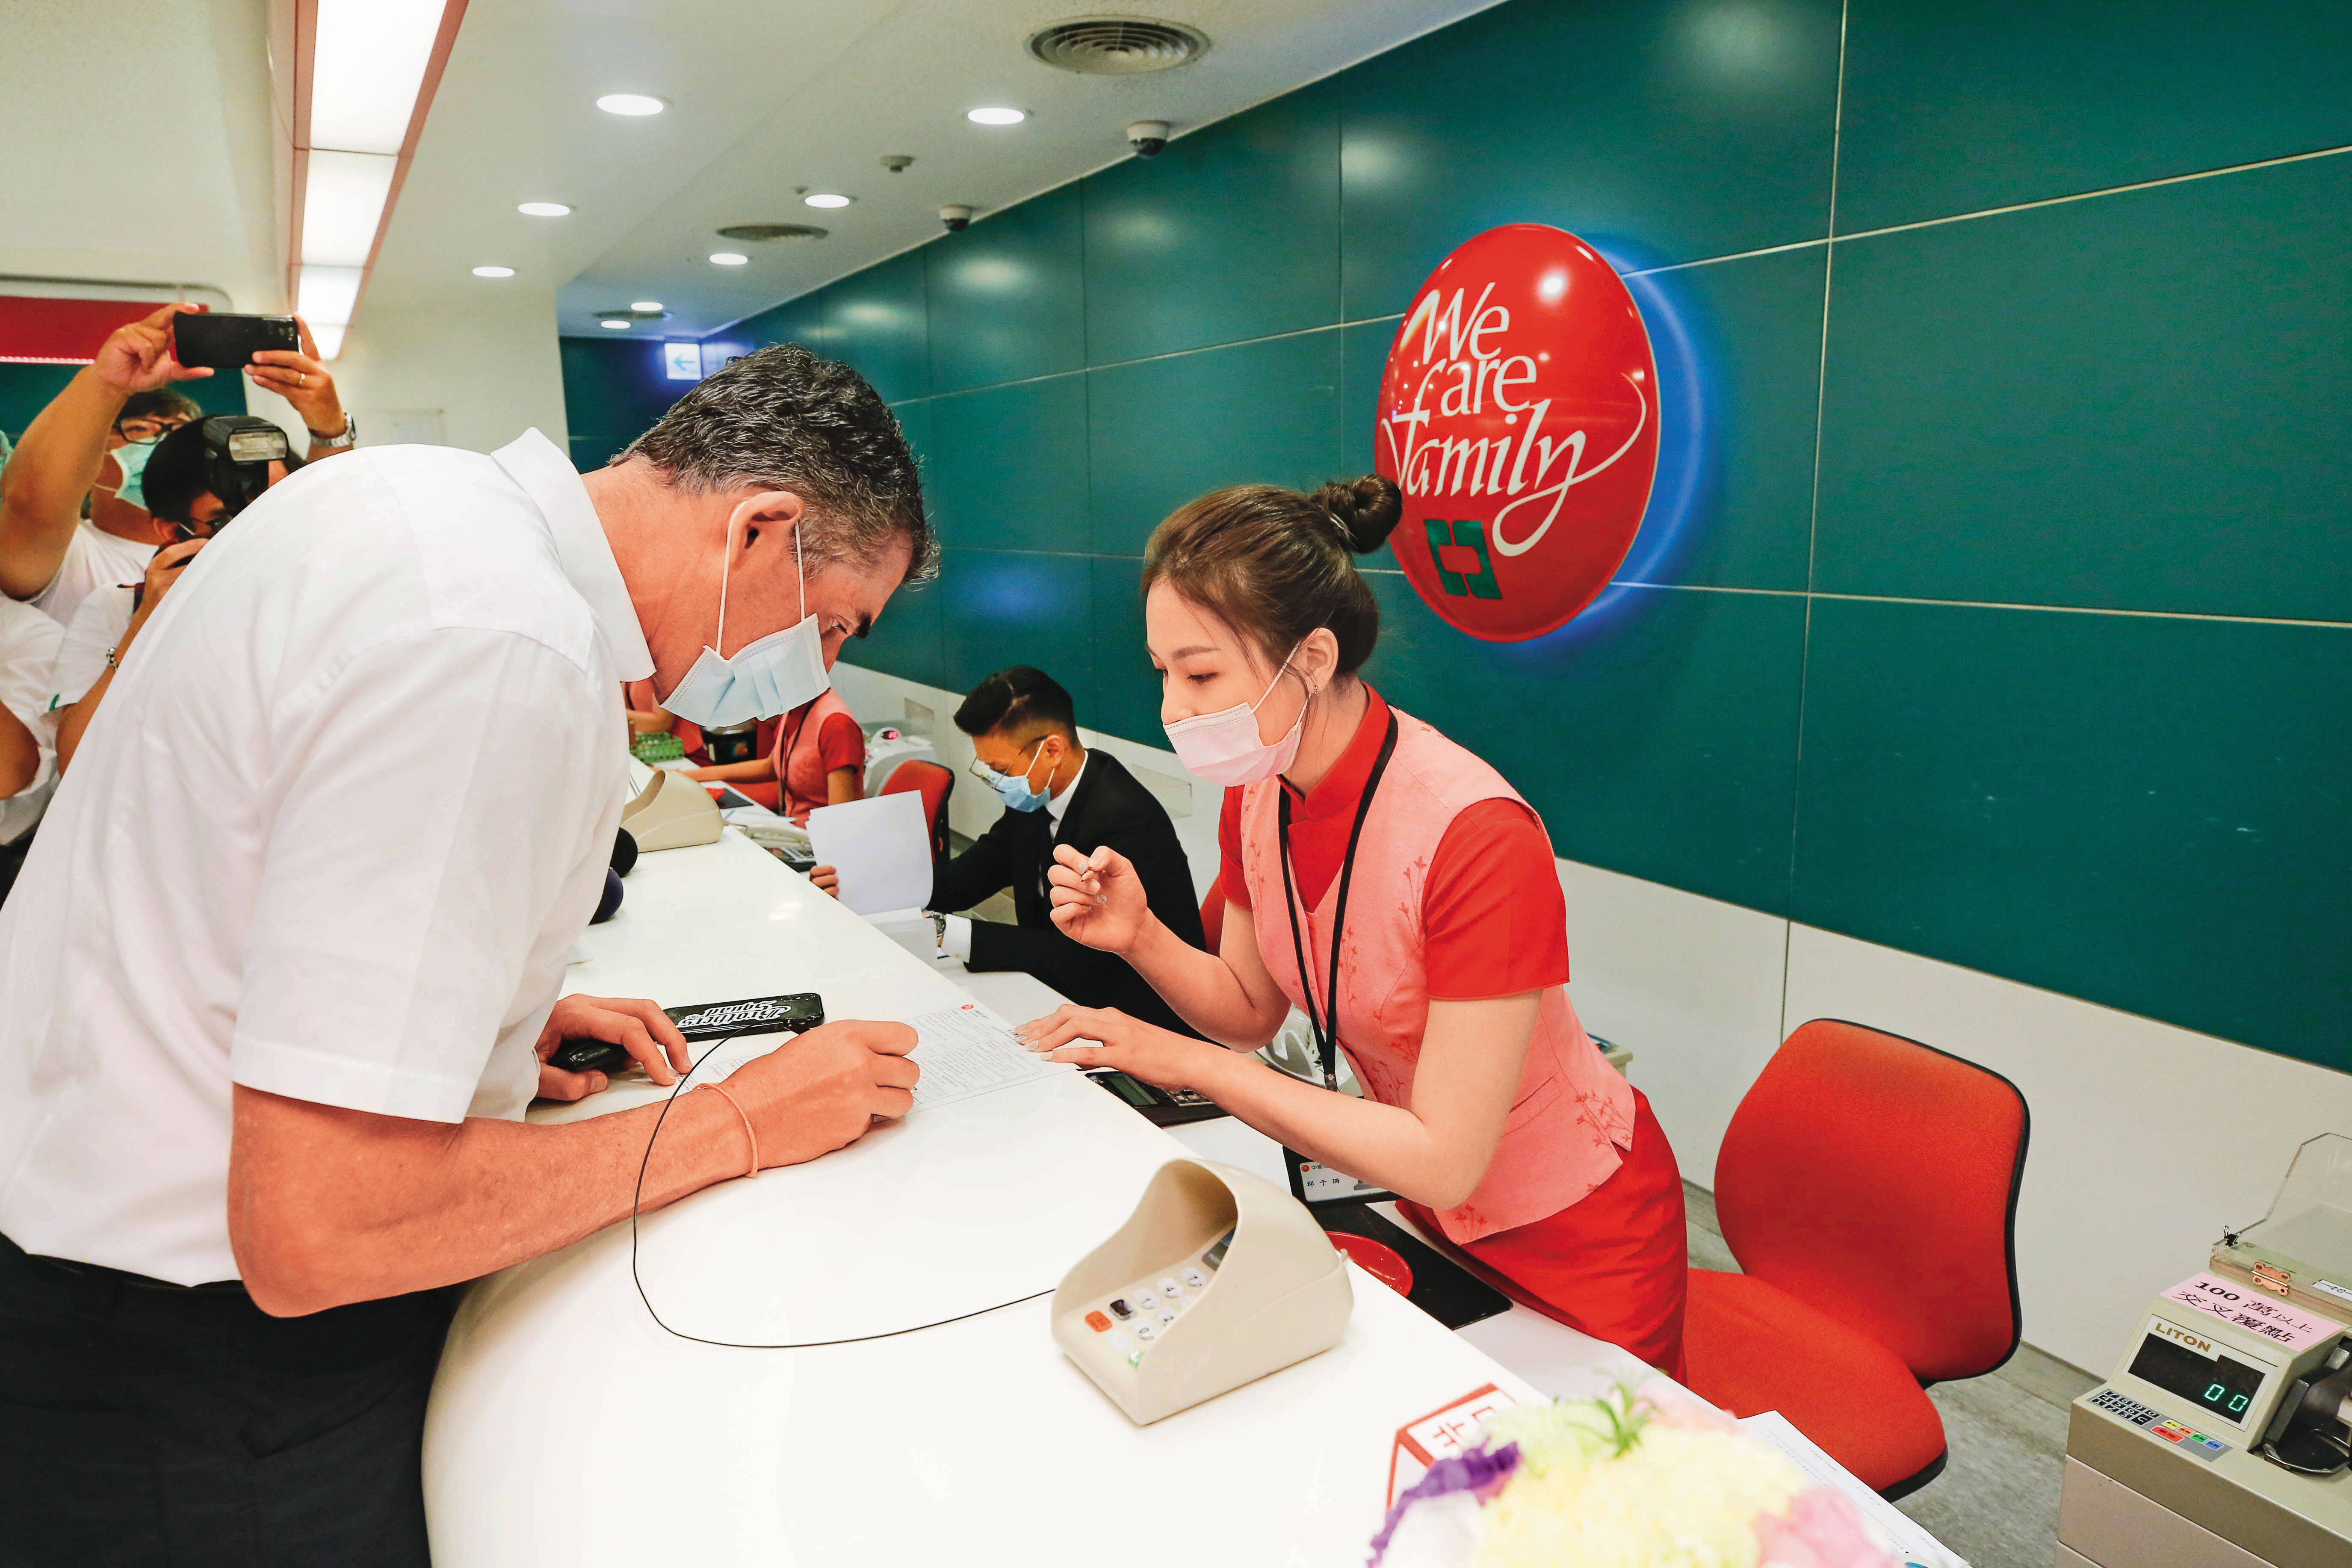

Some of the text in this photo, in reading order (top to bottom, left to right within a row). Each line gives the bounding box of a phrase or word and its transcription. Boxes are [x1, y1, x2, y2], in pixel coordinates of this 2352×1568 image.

[1401, 282, 1510, 365] We
[1380, 357, 1646, 557] family
[677, 1005, 792, 1028] Brothers
[2172, 1291, 2295, 1343] 交叉覆點
[2195, 1282, 2313, 1333] 100 萬以上
[2155, 1323, 2211, 1352] LITON
